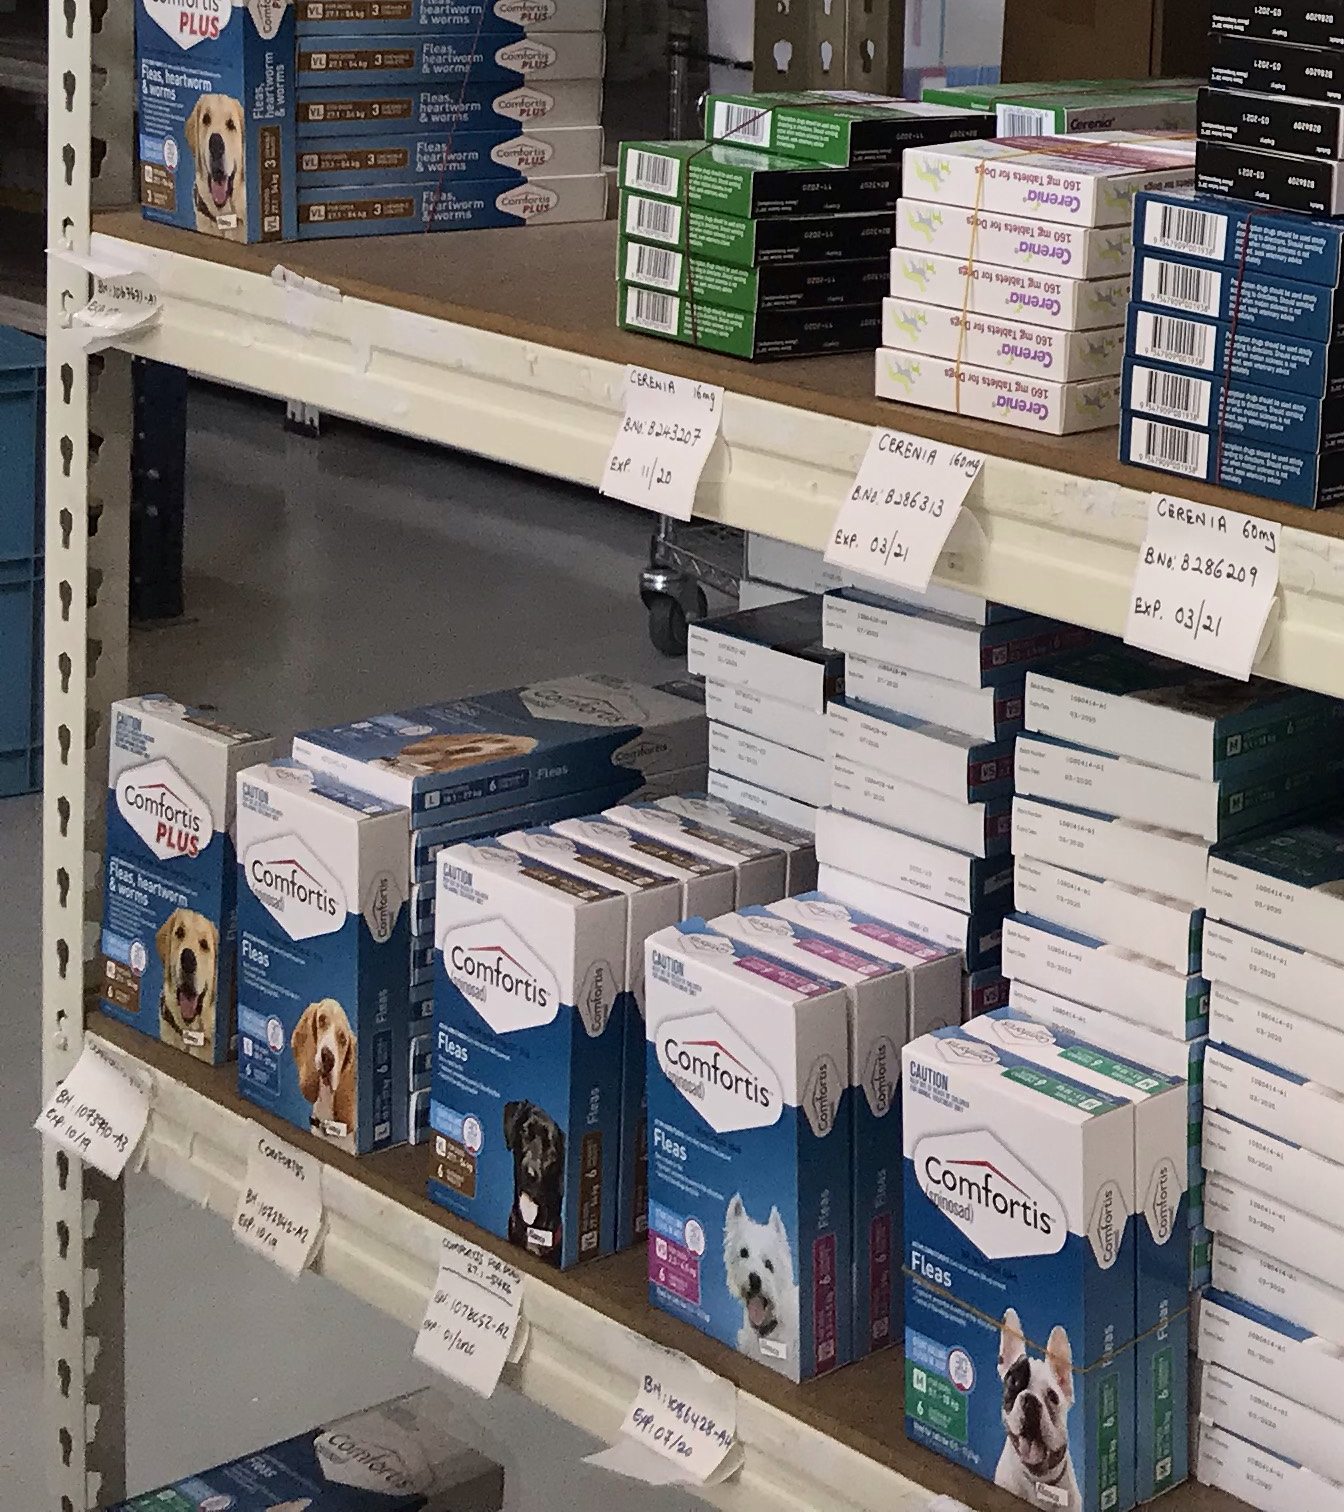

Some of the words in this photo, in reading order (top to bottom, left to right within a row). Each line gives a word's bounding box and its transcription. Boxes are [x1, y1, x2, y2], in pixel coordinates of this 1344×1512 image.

[179, 11, 220, 38] PLUS
[630, 370, 675, 395] CERENIA
[878, 434, 938, 465] CERENIA
[1157, 498, 1227, 533] CERENIA
[1175, 600, 1222, 640] 03/21
[124, 785, 200, 832] Comfortis
[156, 821, 200, 858] PLUS
[252, 857, 339, 917] Comfortis
[451, 945, 548, 1008] Comfortis
[437, 1030, 469, 1063] Fleas
[664, 1038, 770, 1110] Comfortis
[909, 1061, 950, 1092] CAUTION
[653, 1126, 688, 1163] Fleas
[925, 1155, 1052, 1236] Comfortis
[1102, 1189, 1113, 1262] Comfortis
[911, 1251, 953, 1289] Fleas
